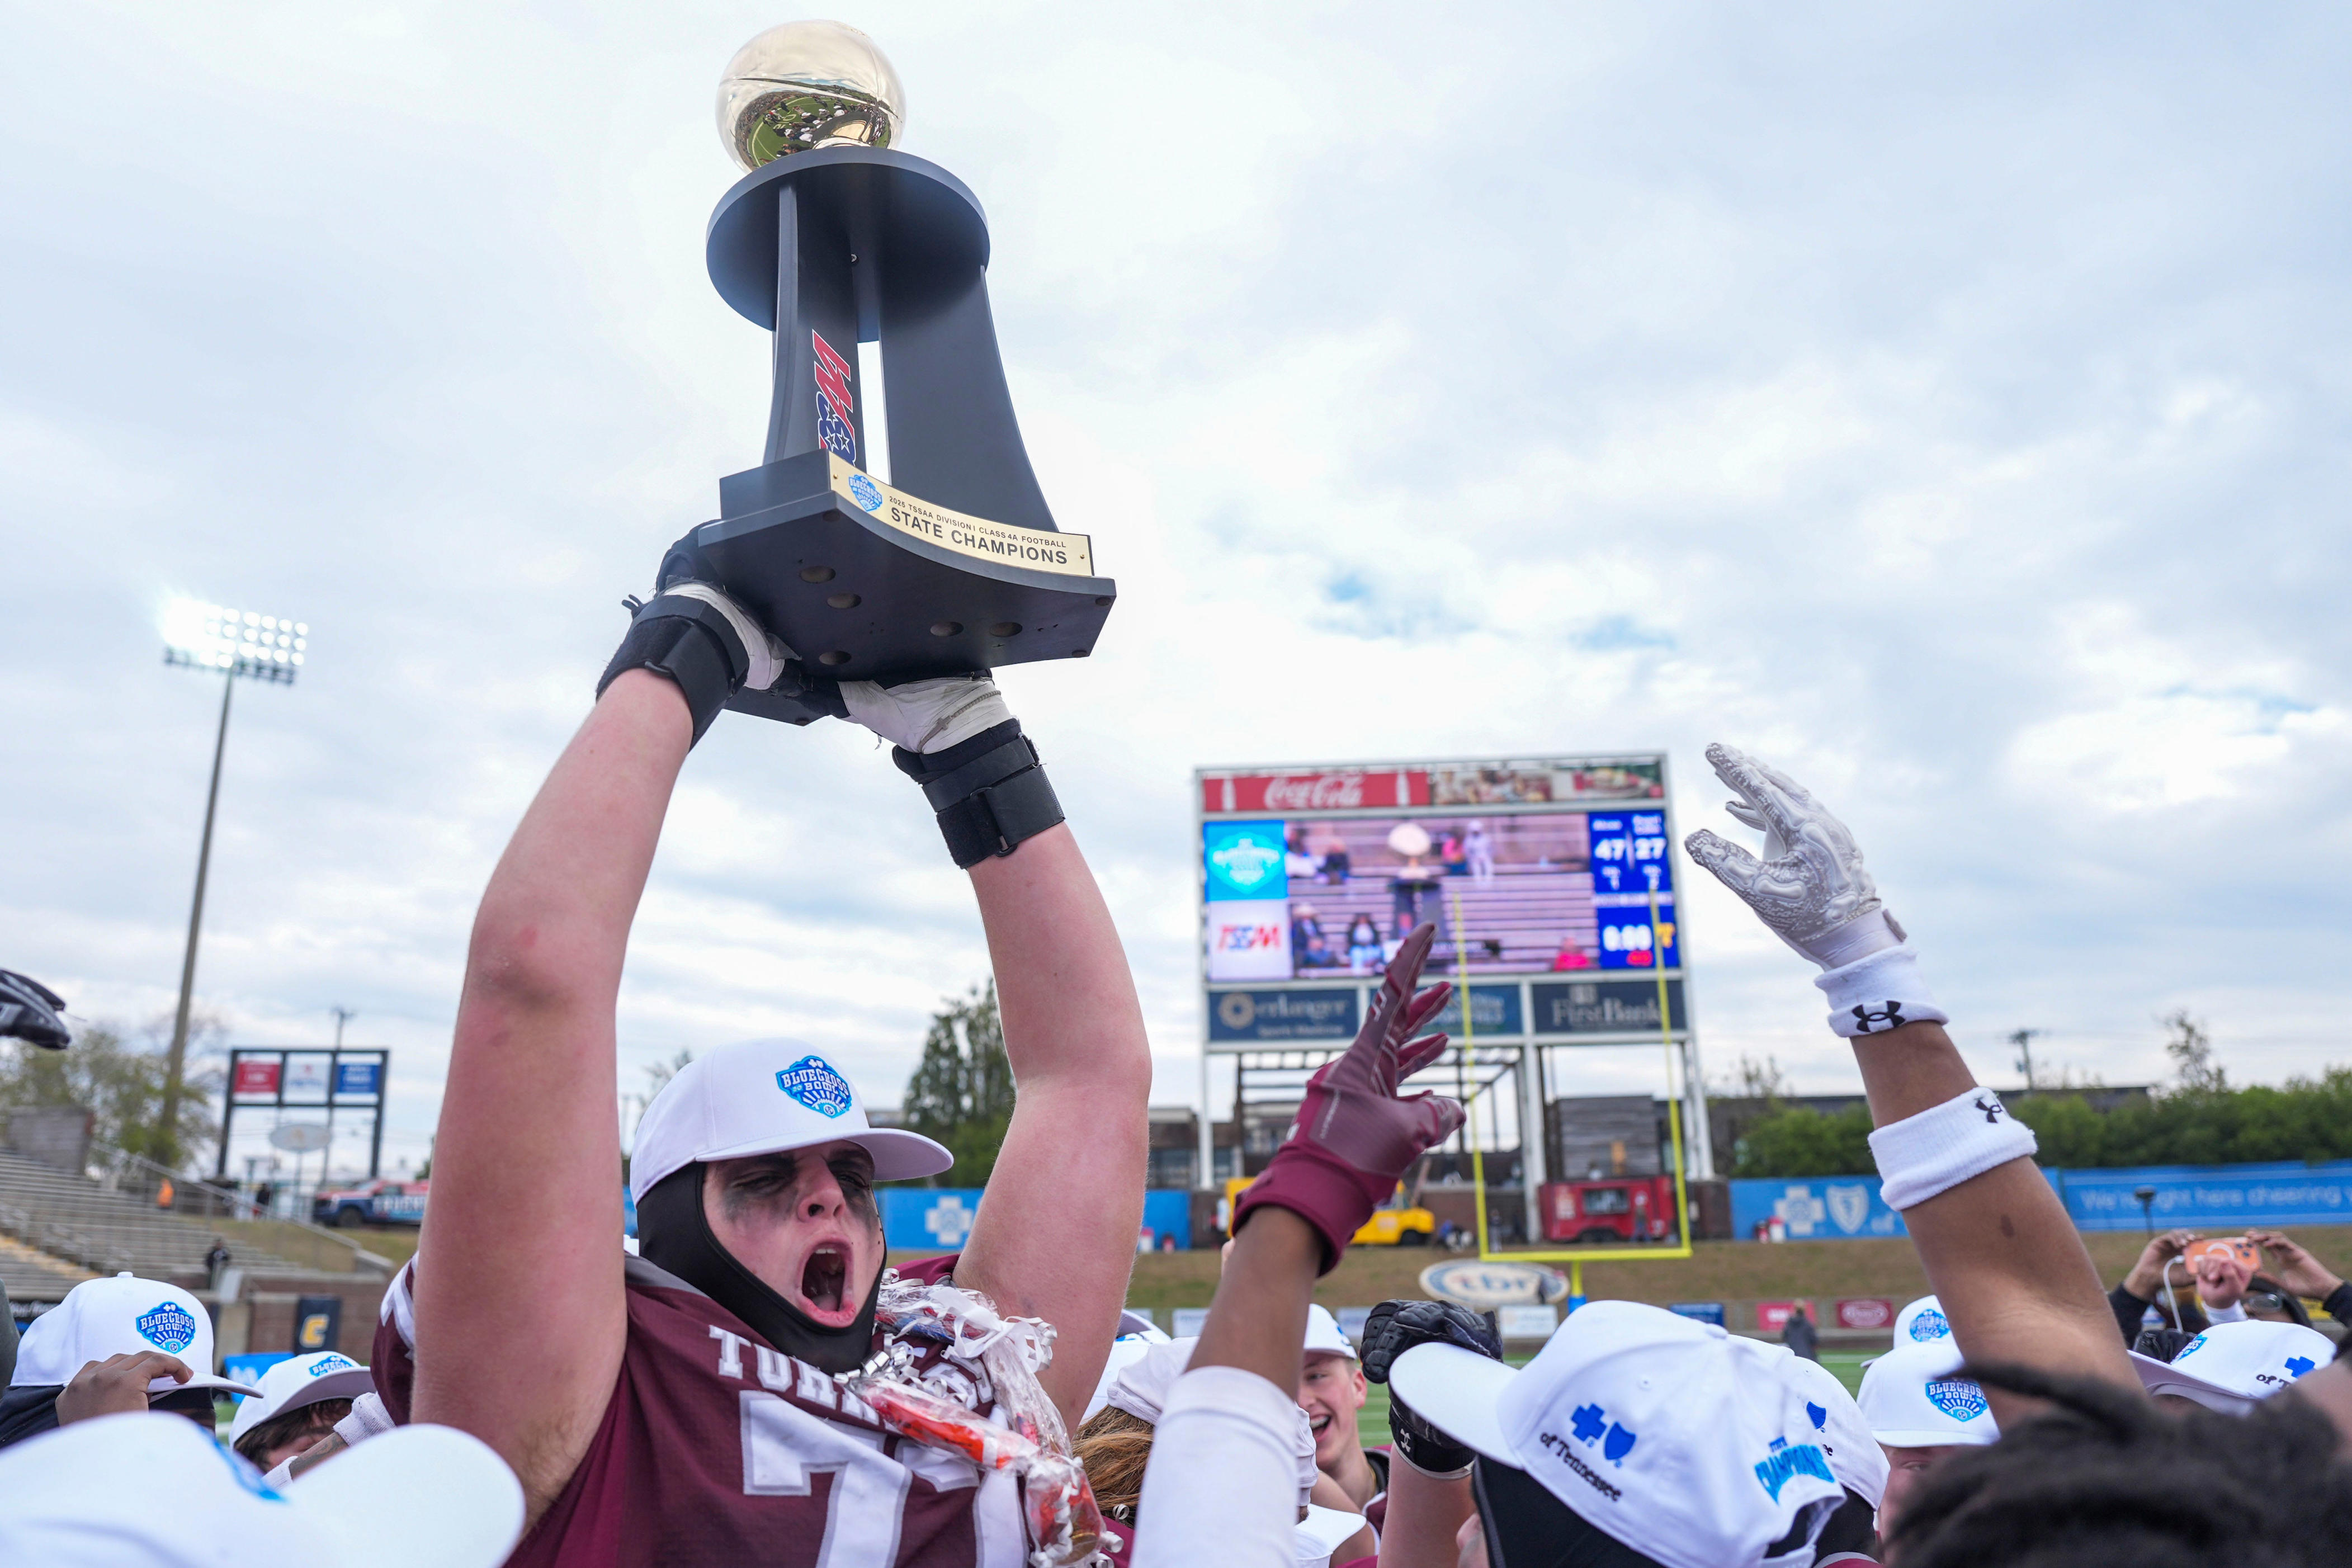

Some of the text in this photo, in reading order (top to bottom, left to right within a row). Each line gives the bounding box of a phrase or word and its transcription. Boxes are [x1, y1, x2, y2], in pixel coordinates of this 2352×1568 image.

[889, 495, 906, 508] 2025
[908, 503, 933, 519] TSSAA
[936, 514, 971, 530] DIVISION
[979, 527, 1007, 539] CLASS
[1022, 536, 1067, 548] FOOTBALL
[891, 507, 1068, 565] STATE CHAMPIONS
[1594, 837, 1667, 861] 47 27
[781, 1068, 849, 1096] BLUECROSS
[804, 1081, 839, 1094] BOWL
[140, 1312, 194, 1330] BLUECROSS
[157, 1323, 185, 1331] BOWL
[1945, 1391, 1975, 1401] BOWL
[1540, 1432, 1622, 1502] of Tennessee
